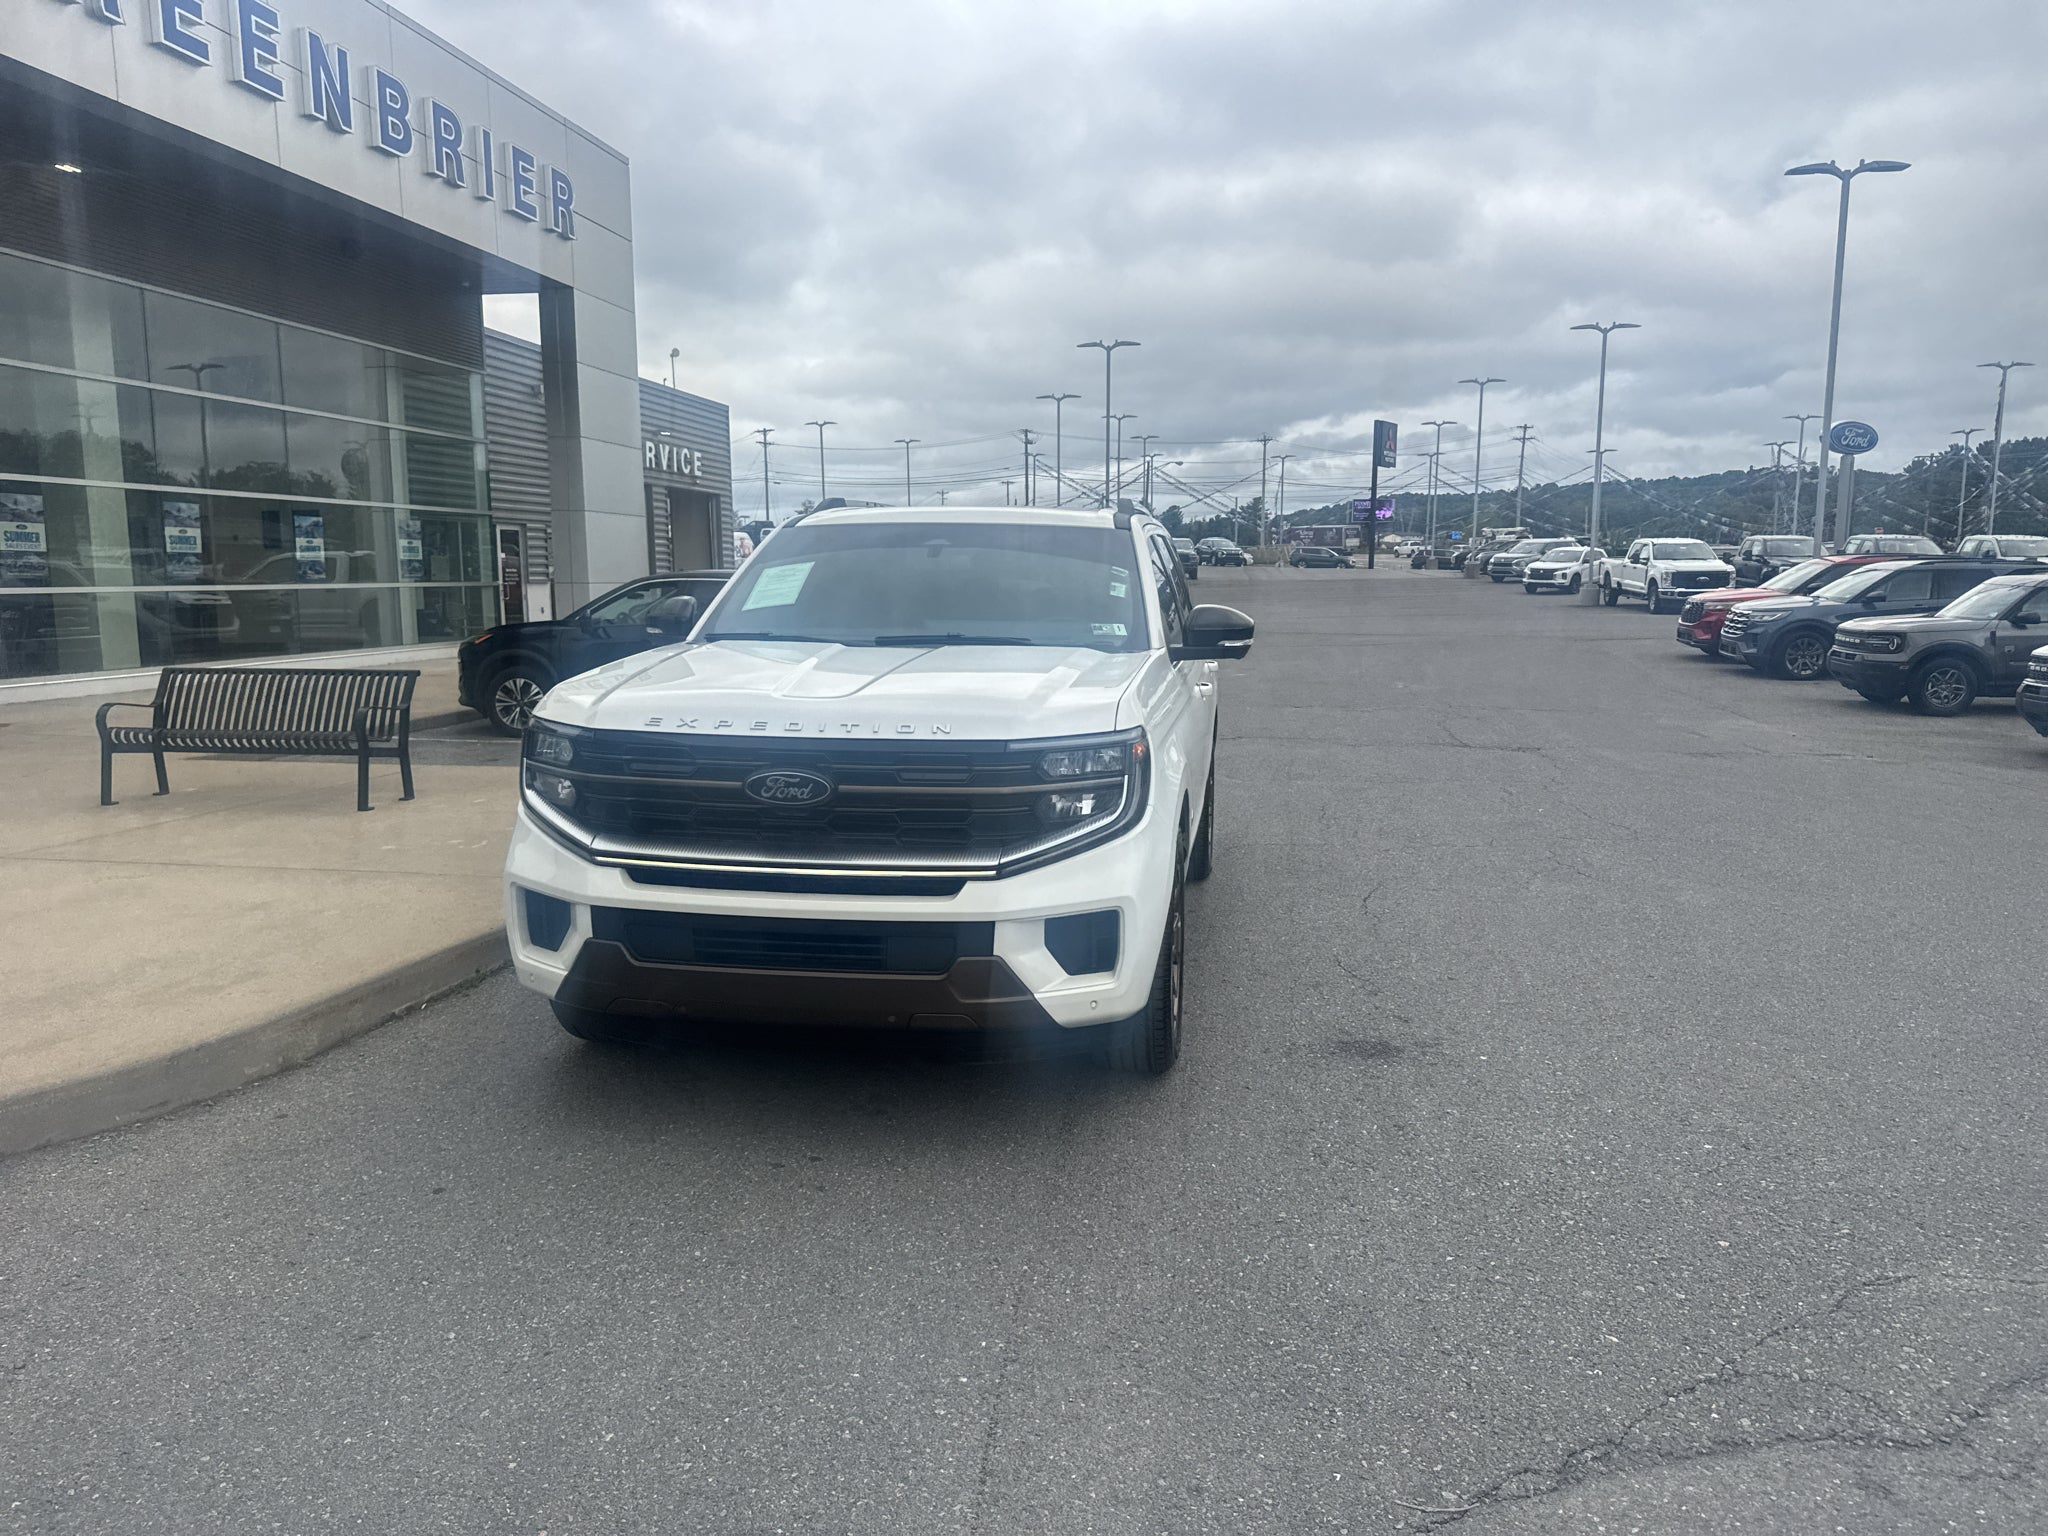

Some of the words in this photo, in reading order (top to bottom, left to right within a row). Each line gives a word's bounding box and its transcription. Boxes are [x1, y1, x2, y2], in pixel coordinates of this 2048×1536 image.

[1841, 427, 1870, 447] Ford
[644, 717, 951, 734] EXPEDITION
[761, 776, 813, 799] Ford
